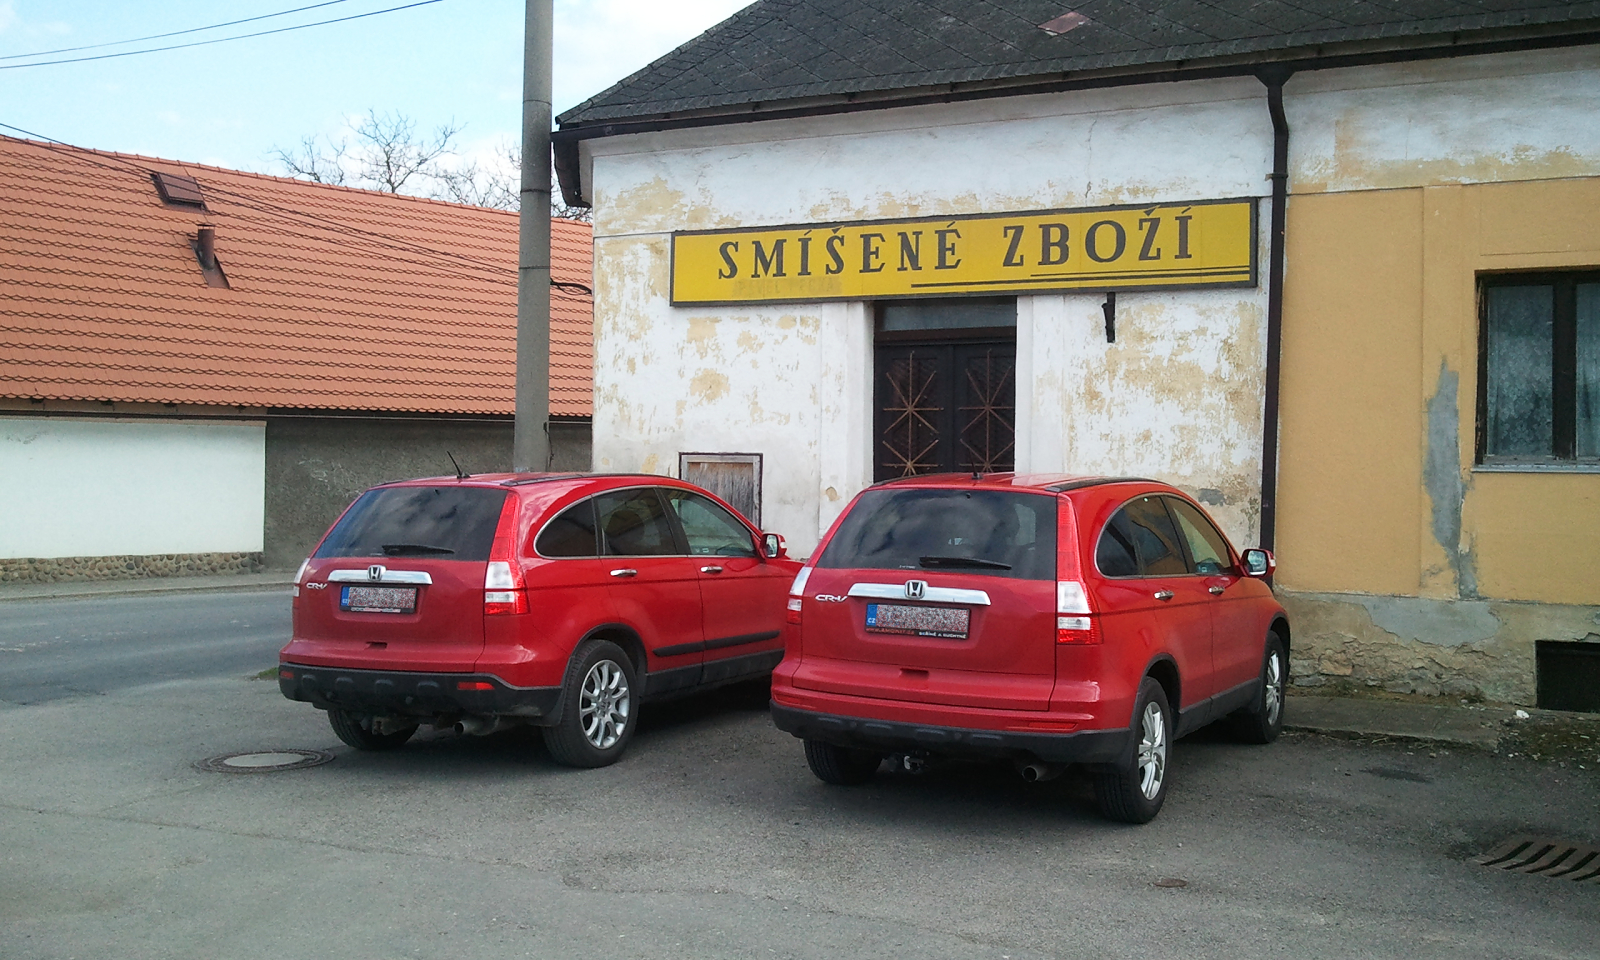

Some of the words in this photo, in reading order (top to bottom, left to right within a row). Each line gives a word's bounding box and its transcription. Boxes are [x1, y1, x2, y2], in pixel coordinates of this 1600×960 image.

[718, 221, 962, 280] SMÍŠENÉ
[1002, 205, 1193, 268] ZBOŽÍ
[815, 594, 848, 603] CR-V
